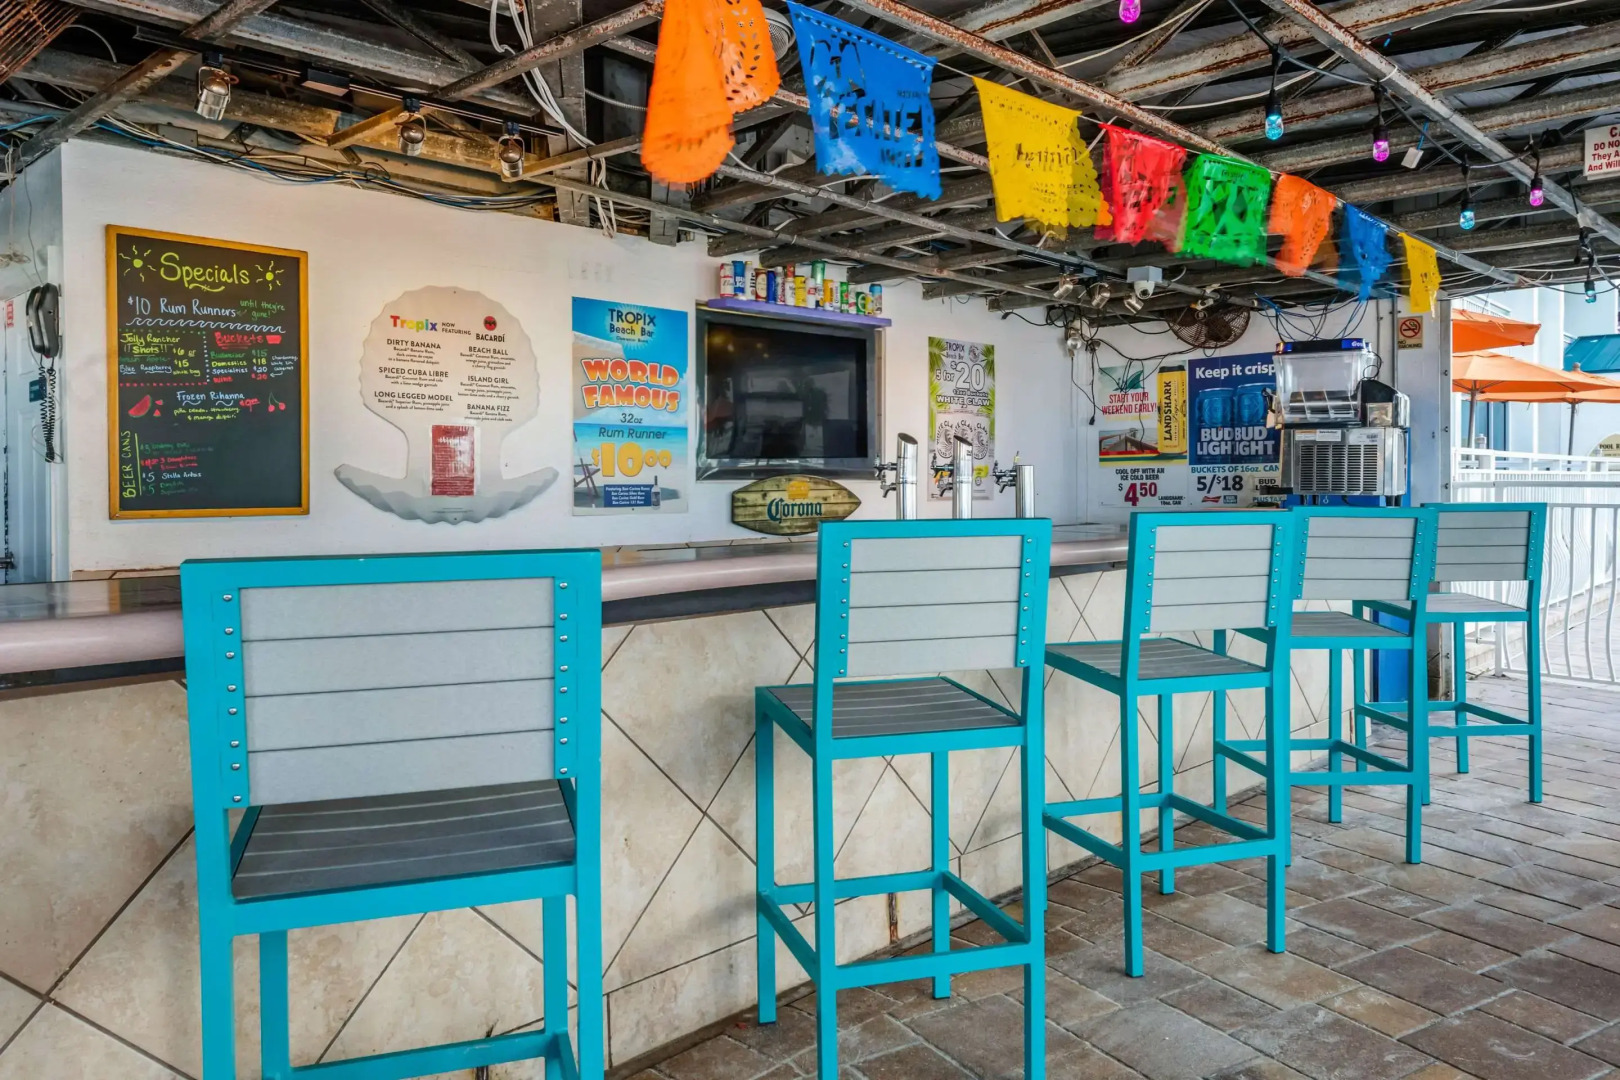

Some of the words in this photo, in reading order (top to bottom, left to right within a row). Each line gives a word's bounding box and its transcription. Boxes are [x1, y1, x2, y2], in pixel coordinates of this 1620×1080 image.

[1594, 142, 1605, 151] DO
[1592, 153, 1612, 161] They
[1588, 163, 1602, 172] And
[160, 252, 250, 288] Specials
[128, 297, 150, 315] $10
[160, 298, 186, 315] Rum
[192, 299, 236, 317] Runners
[390, 315, 438, 333] Tropix
[608, 308, 656, 327] TROPIX
[609, 323, 635, 335] Beach
[641, 327, 654, 337] Bar
[120, 333, 145, 346] Jolly
[147, 333, 180, 343] Rancher
[215, 332, 264, 345] Buckets
[476, 333, 505, 343] BACARDÍ
[411, 341, 441, 349] BANANA
[946, 342, 964, 352] TROPIX
[174, 359, 189, 367] $15
[581, 358, 679, 387] WORLD
[936, 369, 941, 380] 5
[943, 370, 954, 382] for
[950, 360, 985, 391] $20
[1196, 367, 1229, 379] Keep
[1232, 364, 1242, 376] it
[176, 391, 206, 401] Frozen
[210, 392, 245, 400] Rihanna
[582, 384, 681, 413] FAMOUS
[936, 395, 964, 404] WHITE
[966, 397, 990, 406] CLAW
[1109, 393, 1129, 403] START
[1131, 392, 1149, 402] YOUR
[1102, 405, 1132, 415] WEEKEND
[1135, 403, 1156, 413] EARLY!
[1164, 381, 1172, 441] LANDSHARK
[620, 413, 643, 424] 32oz
[599, 427, 624, 438] Rum
[628, 428, 667, 439] Runner
[1201, 428, 1234, 441] BUD
[121, 430, 131, 458] CANS
[1191, 466, 1226, 474] BUCKETS
[1227, 465, 1239, 473] OF
[1241, 465, 1261, 473] 16oz.
[122, 464, 136, 498] BEER
[1196, 475, 1243, 494] 5/$18
[767, 497, 823, 524] Corona
